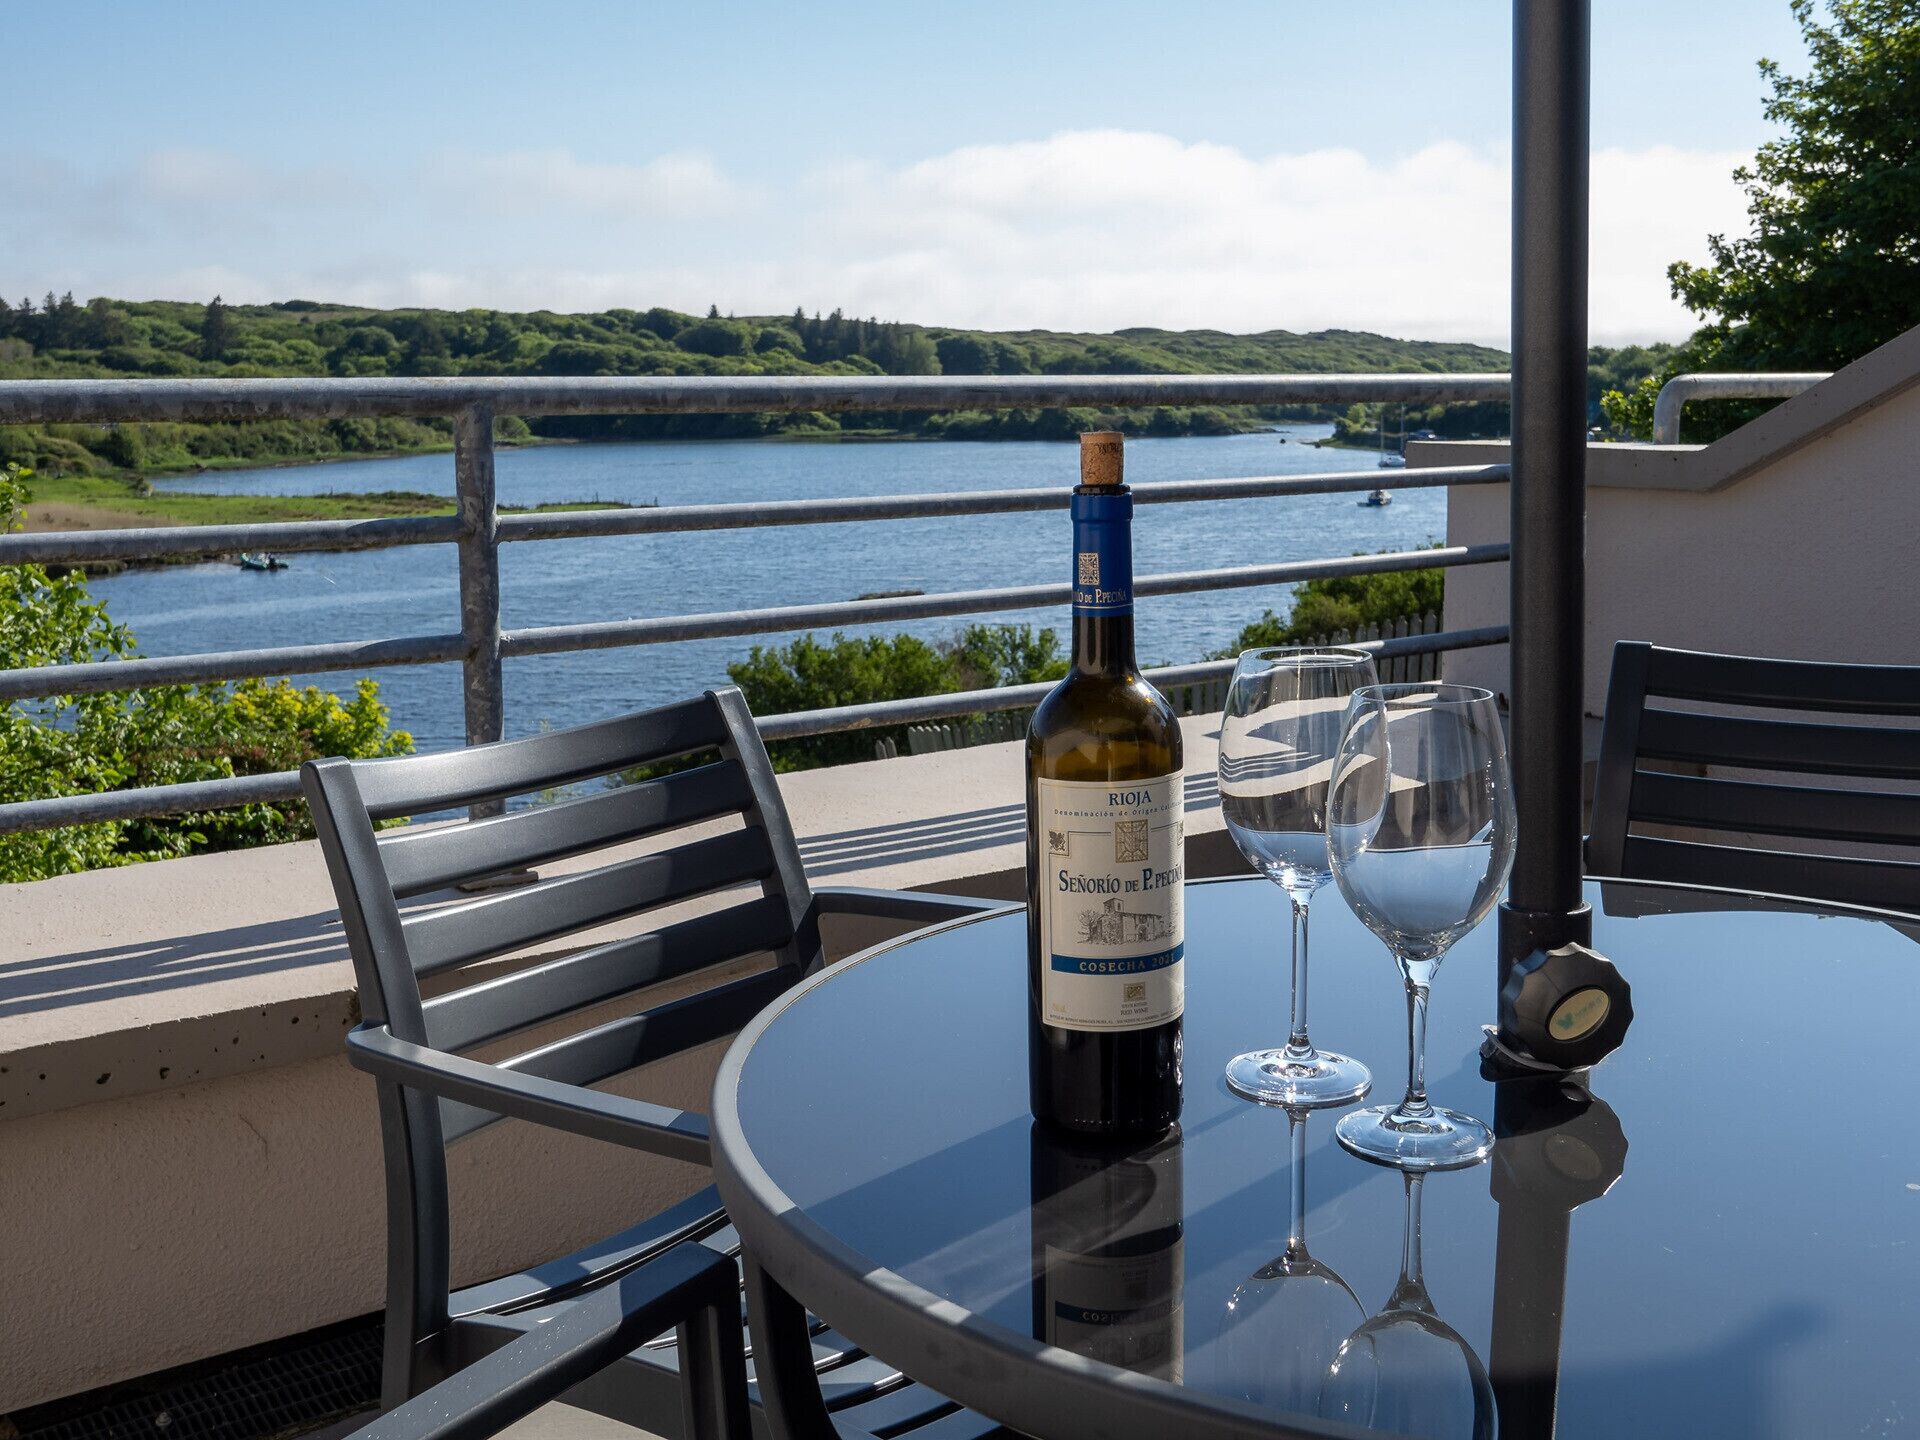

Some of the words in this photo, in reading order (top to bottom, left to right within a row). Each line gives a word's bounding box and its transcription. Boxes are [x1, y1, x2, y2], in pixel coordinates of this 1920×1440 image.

[1108, 790, 1152, 807] RIOJA
[1054, 808, 1114, 818] Denominación
[1118, 809, 1129, 817] de
[1059, 869, 1121, 894] SEÑORÍO
[1125, 880, 1139, 893] DE
[1079, 961, 1146, 972] COSECHA
